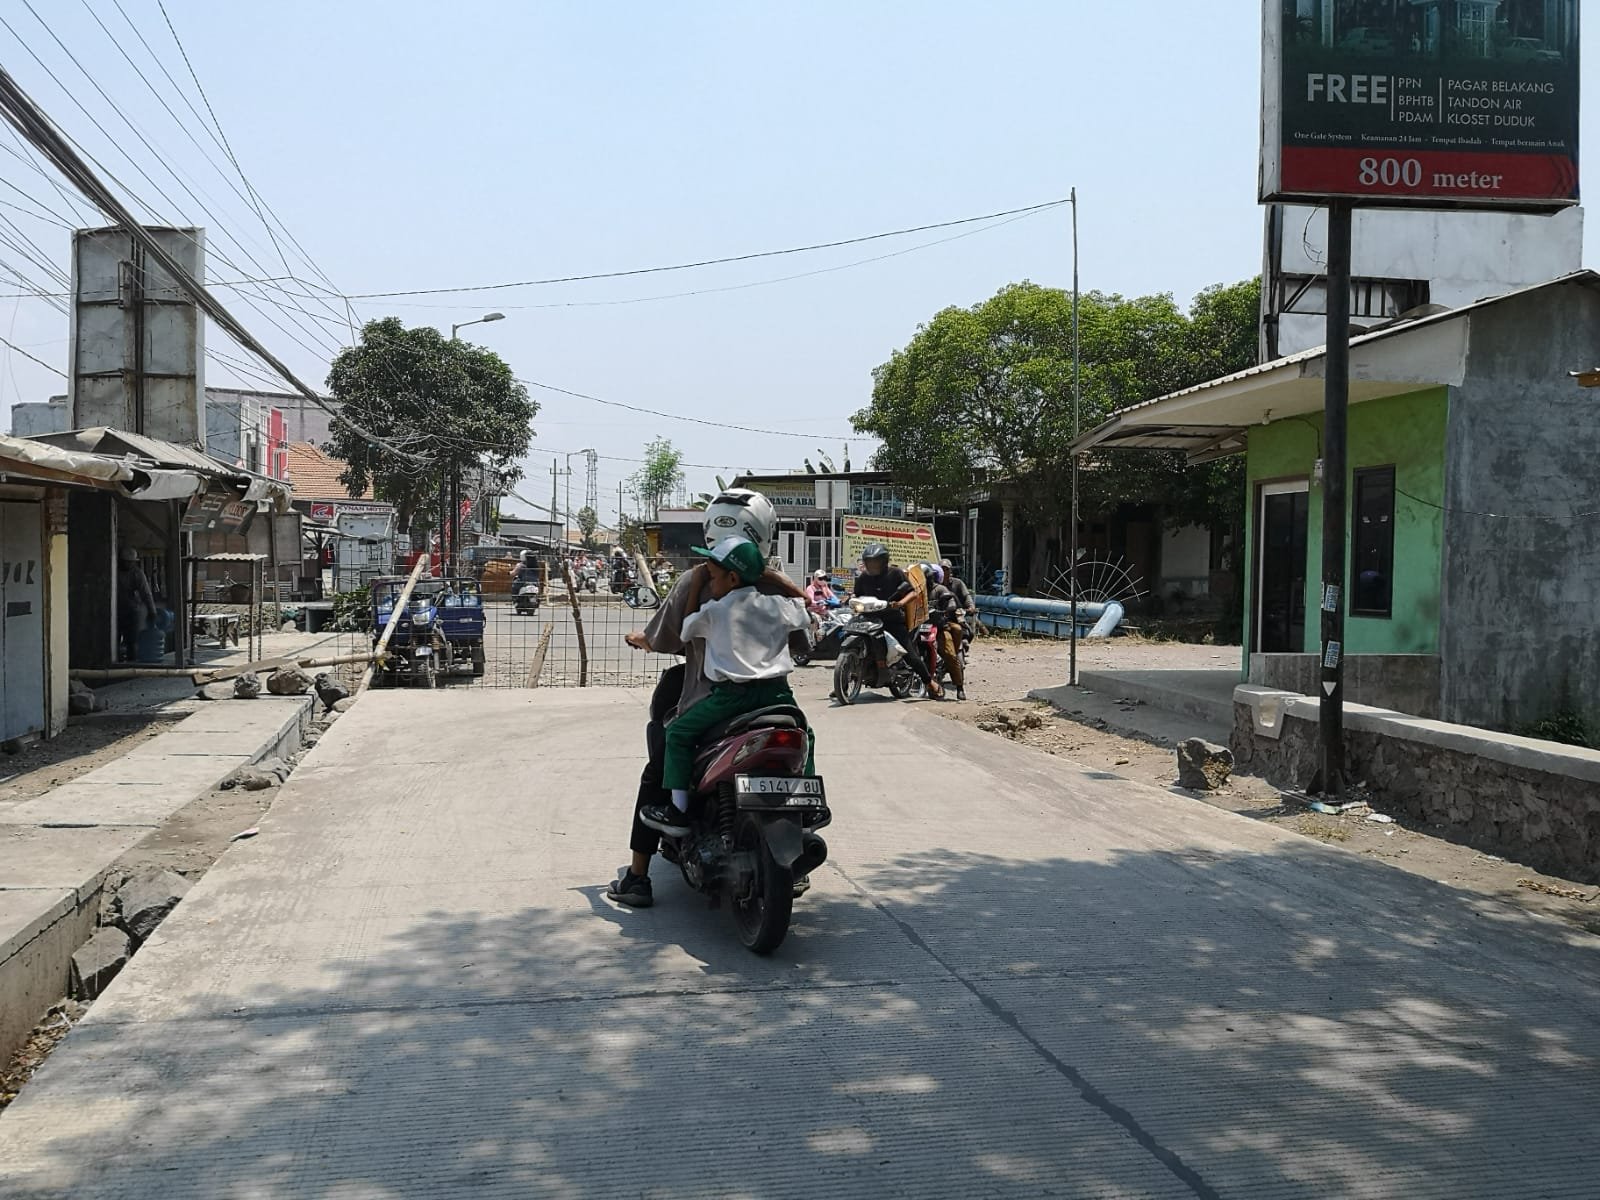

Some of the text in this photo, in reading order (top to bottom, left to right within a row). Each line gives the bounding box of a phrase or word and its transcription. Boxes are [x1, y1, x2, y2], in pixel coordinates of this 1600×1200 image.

[1307, 73, 1387, 104] FREE
[1398, 78, 1422, 88] PPN
[1448, 80, 1554, 93] PAGAR BELAKANG
[1398, 95, 1434, 106] BPHTB
[1448, 97, 1522, 110] TANDON AIR
[1399, 111, 1433, 123] PDAM
[1447, 113, 1535, 127] KLOSET DUDUK
[1359, 157, 1503, 189] 800 meter
[742, 780, 751, 793] W
[760, 780, 790, 793] 6141
